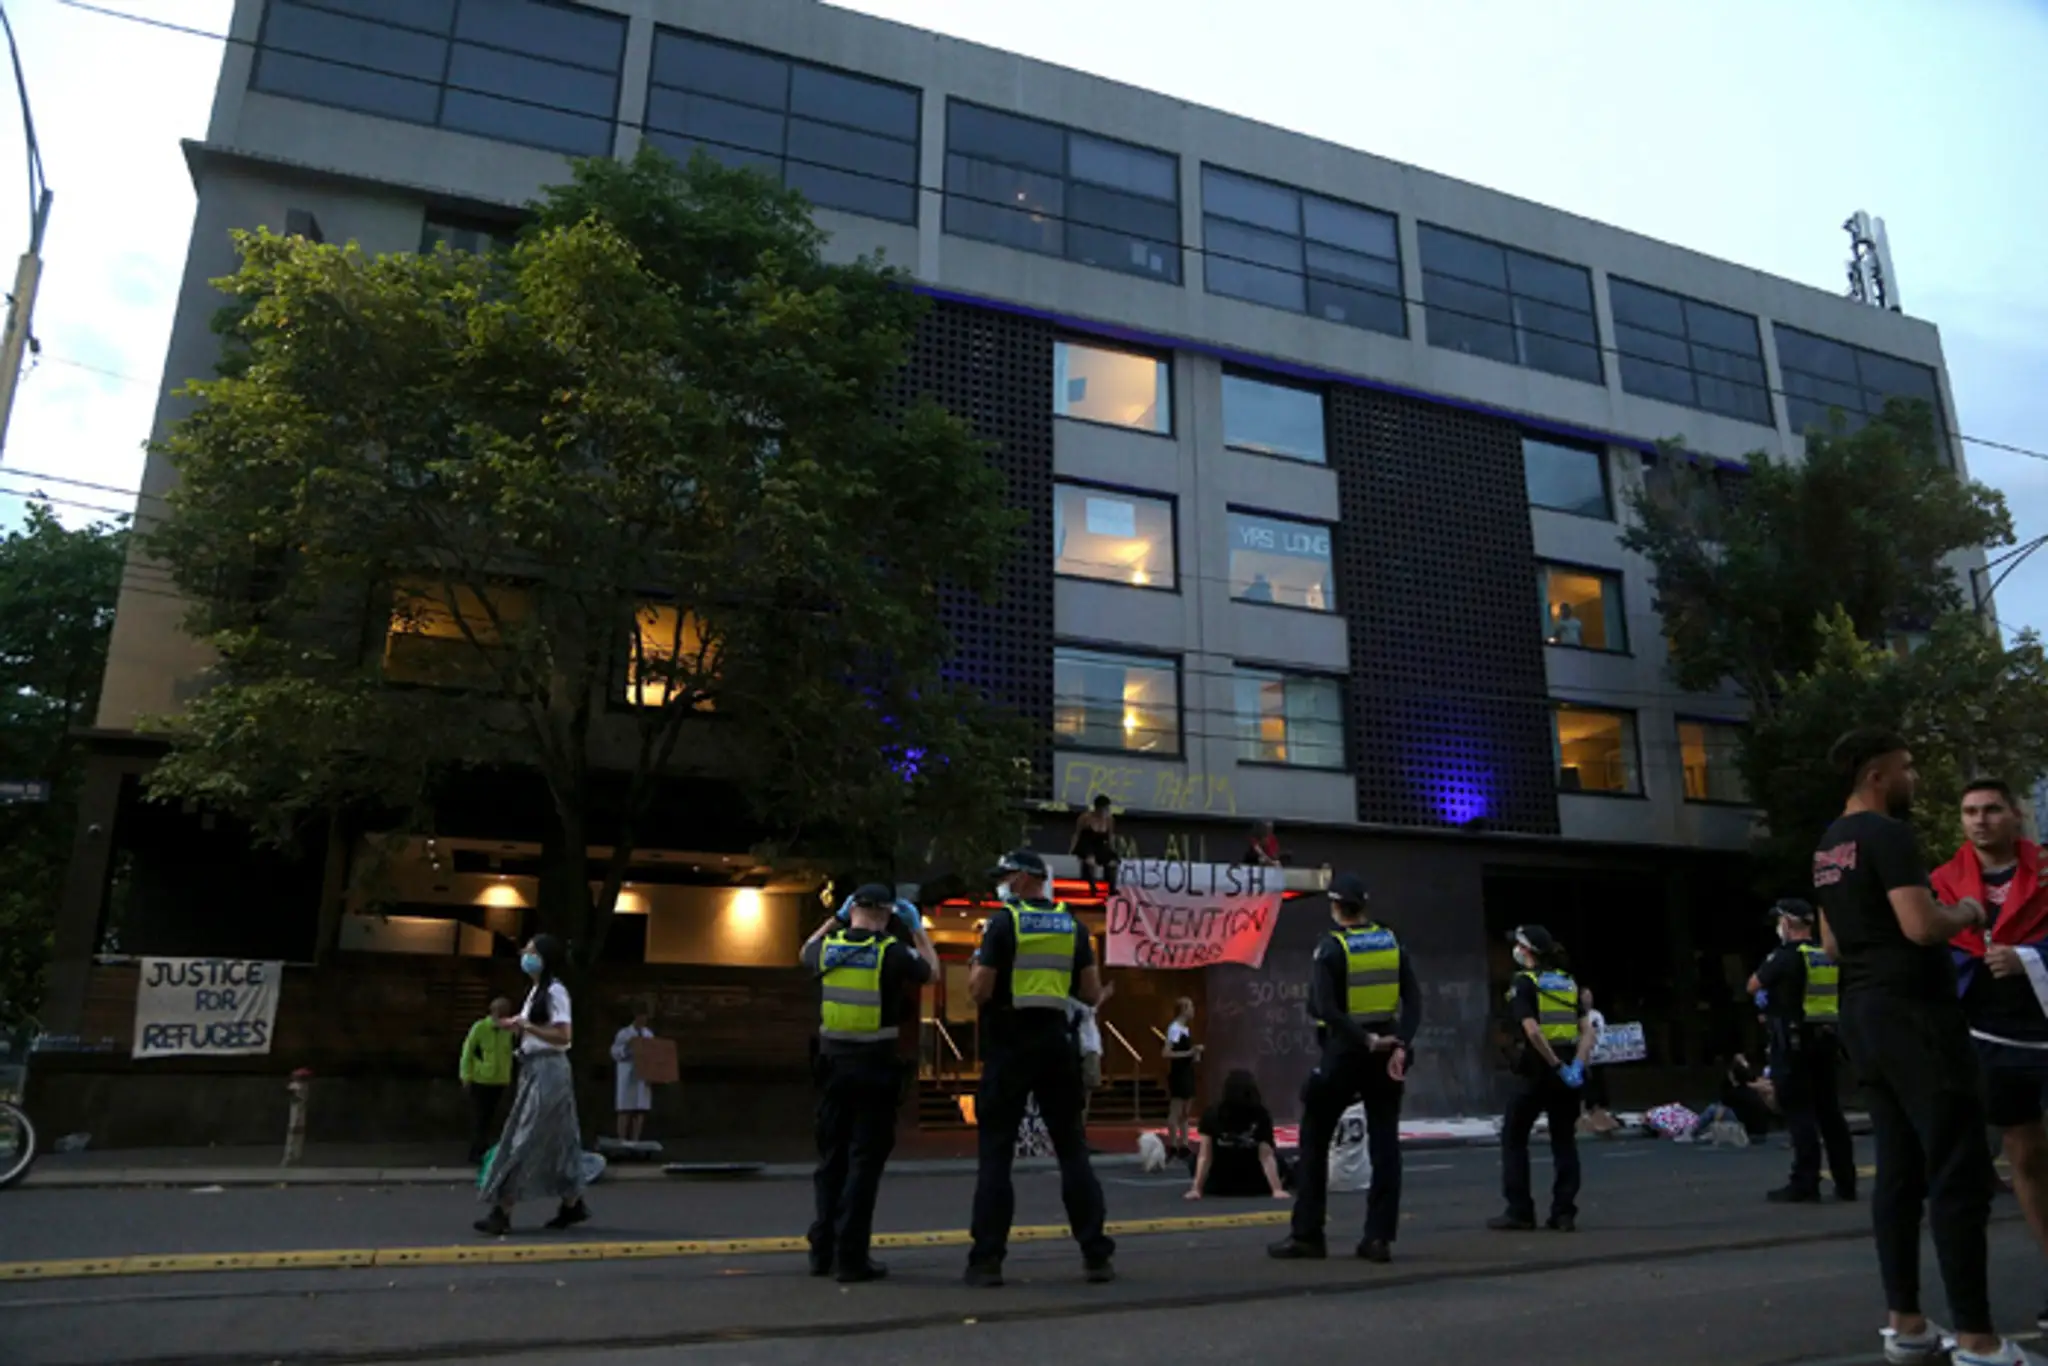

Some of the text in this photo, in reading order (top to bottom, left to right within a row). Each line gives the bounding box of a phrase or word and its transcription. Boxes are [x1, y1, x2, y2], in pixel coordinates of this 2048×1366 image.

[1062, 761, 1142, 806] FREE
[1120, 859, 1265, 897] ABOLISH
[1110, 899, 1268, 939] DETENTION
[147, 960, 263, 987] JUSTICE
[196, 988, 237, 1010] FOR
[144, 1020, 267, 1050] REFUGEES
